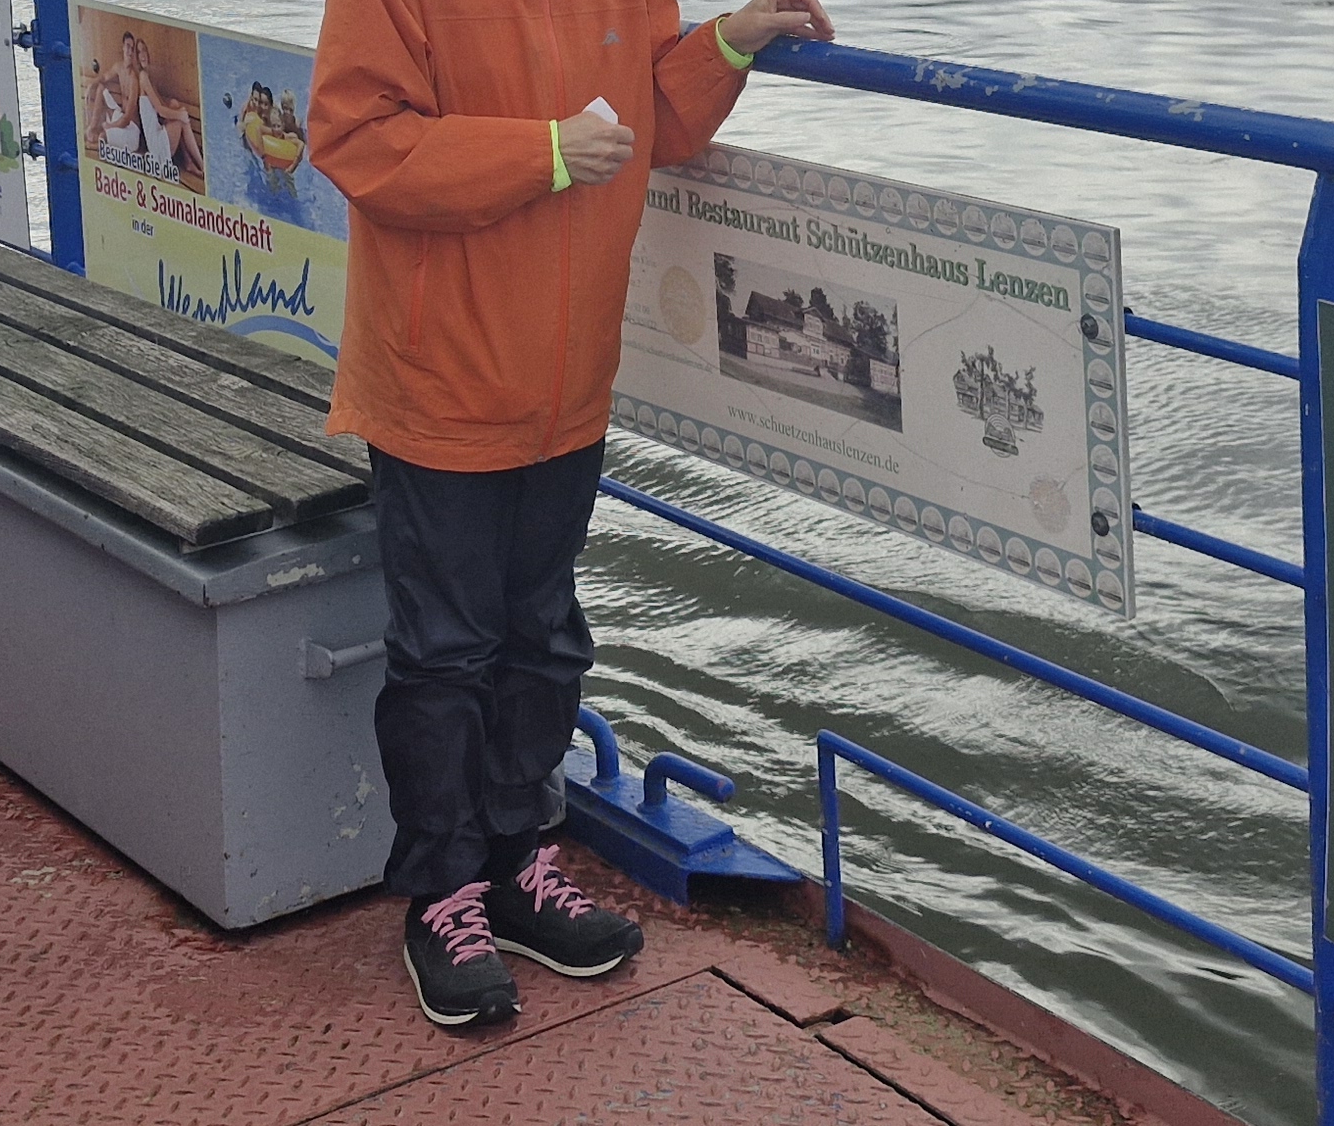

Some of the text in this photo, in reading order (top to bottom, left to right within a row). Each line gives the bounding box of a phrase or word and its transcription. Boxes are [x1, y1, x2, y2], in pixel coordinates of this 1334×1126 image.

[98, 140, 179, 182] Besuchen Sie die
[94, 166, 273, 253] Bade- & Saunalandschaft
[131, 214, 155, 237] in der
[158, 248, 315, 325] Wendland
[646, 187, 1072, 312] und Restaurant Schützenhaus Lenzen
[727, 403, 900, 474] www.schuetzenhauslenzen.de
